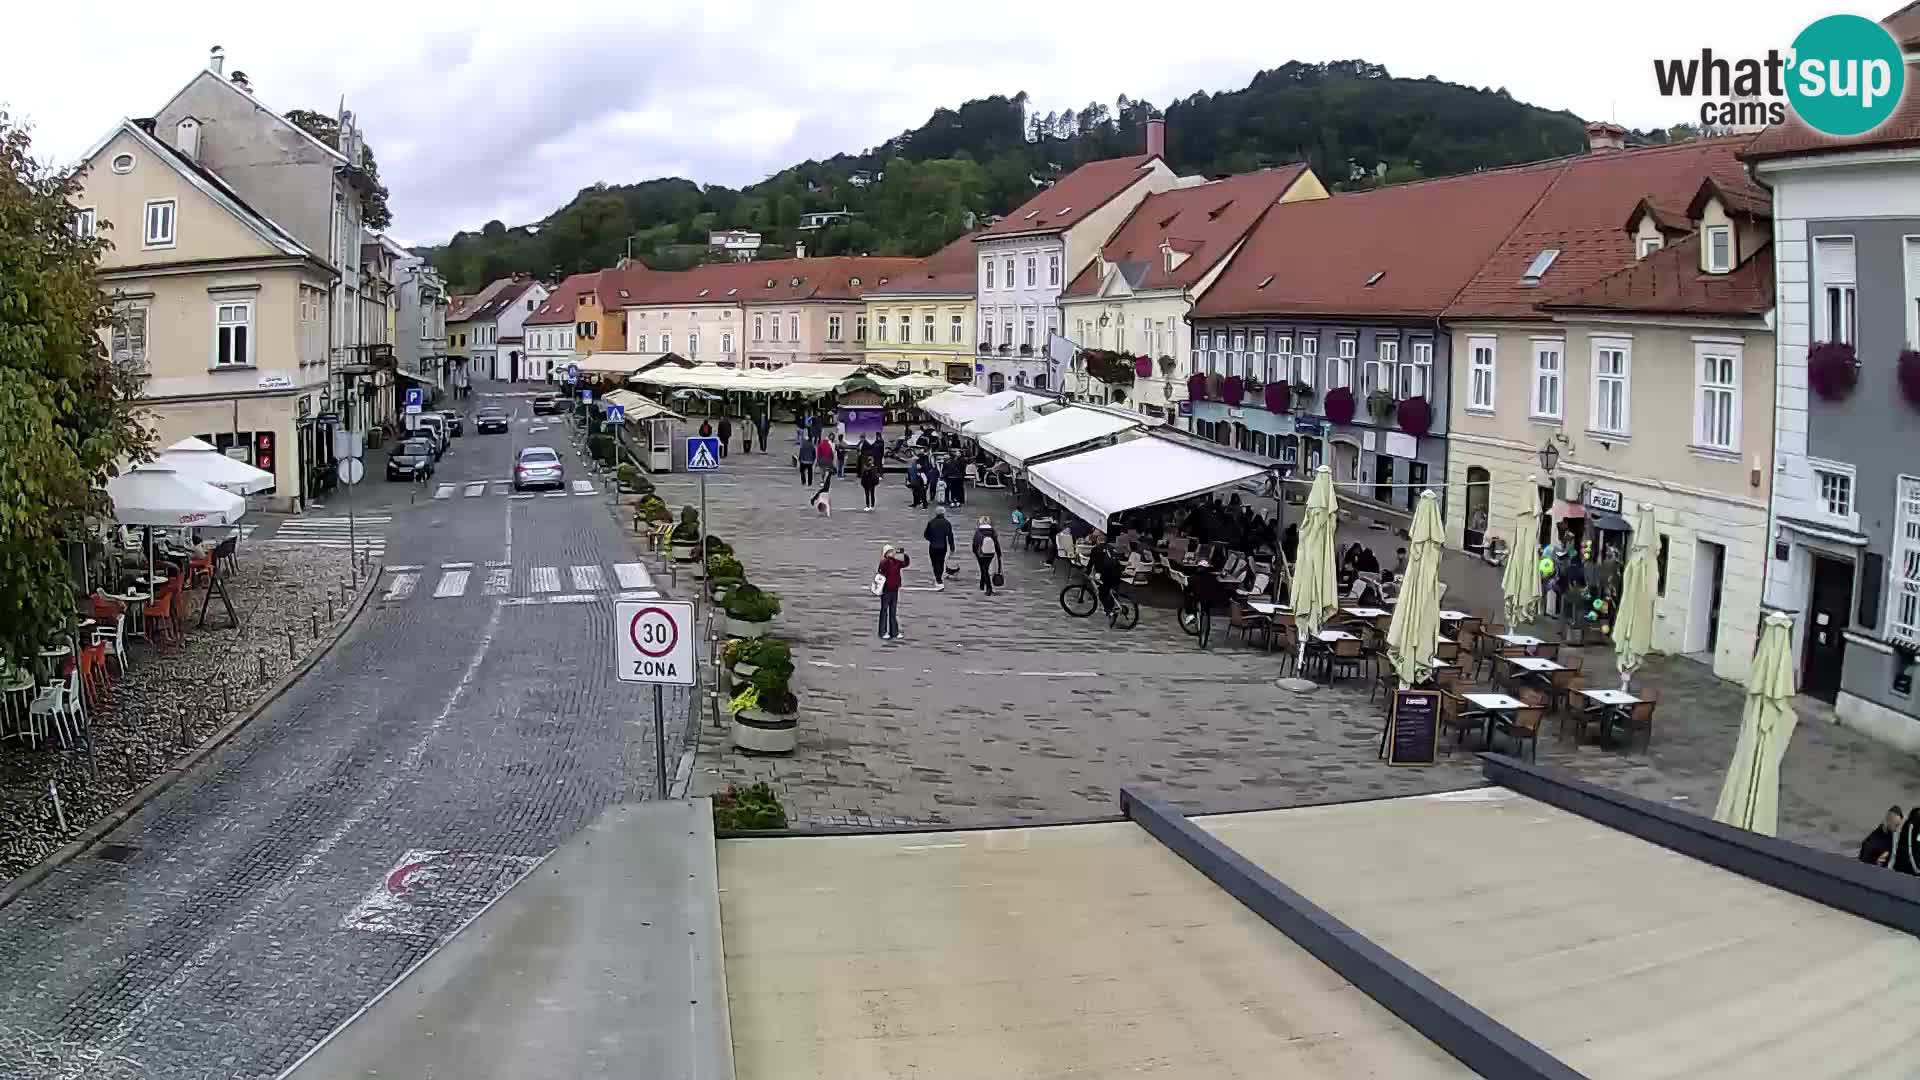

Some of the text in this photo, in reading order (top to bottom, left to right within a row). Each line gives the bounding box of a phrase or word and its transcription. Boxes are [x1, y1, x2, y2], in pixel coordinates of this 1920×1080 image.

[410, 391, 418, 403] P
[642, 623, 667, 644] 30
[633, 660, 677, 677] ZONA
